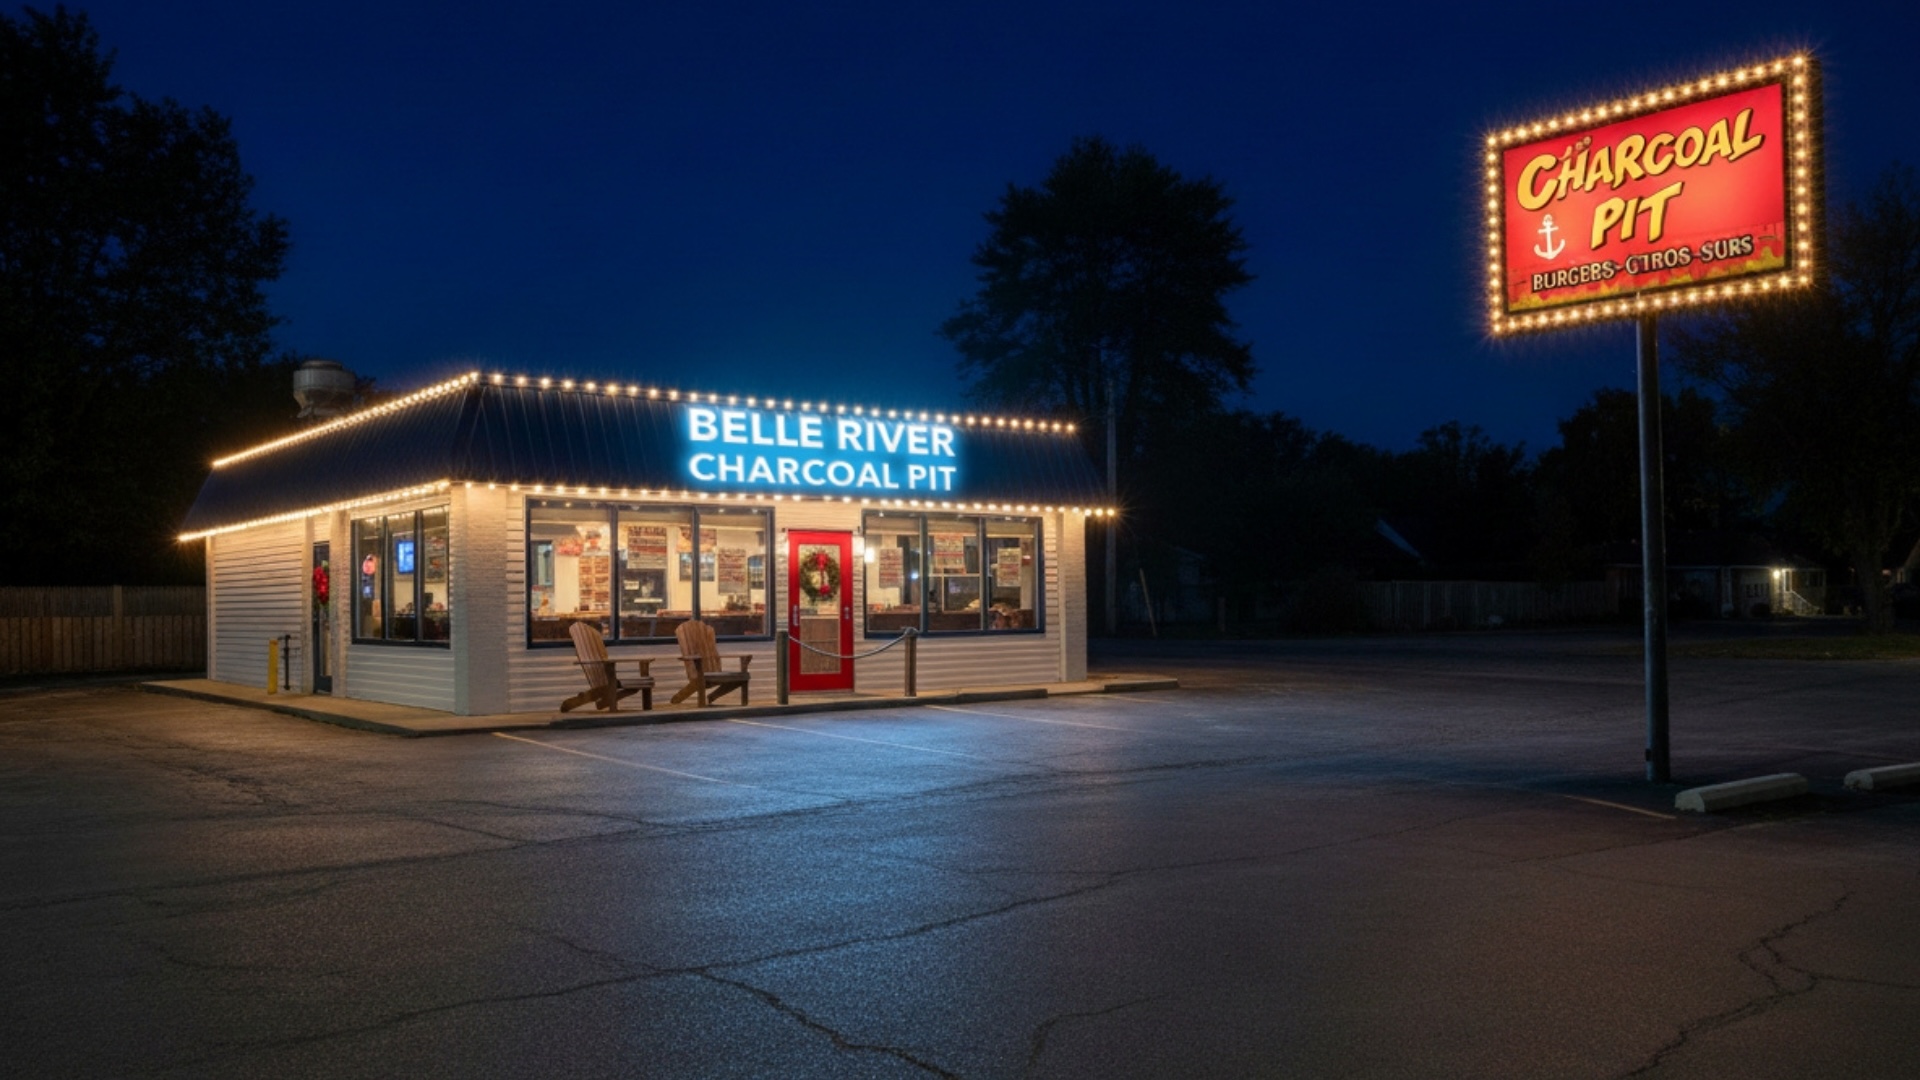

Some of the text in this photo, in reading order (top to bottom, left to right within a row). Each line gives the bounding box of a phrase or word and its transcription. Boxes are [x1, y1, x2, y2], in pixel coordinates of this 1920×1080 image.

[1516, 108, 1764, 211] CHARCOAL
[1590, 181, 1684, 250] PIT
[688, 408, 956, 457] BELLE RIVER
[688, 453, 956, 491] CHARCOAL PIT
